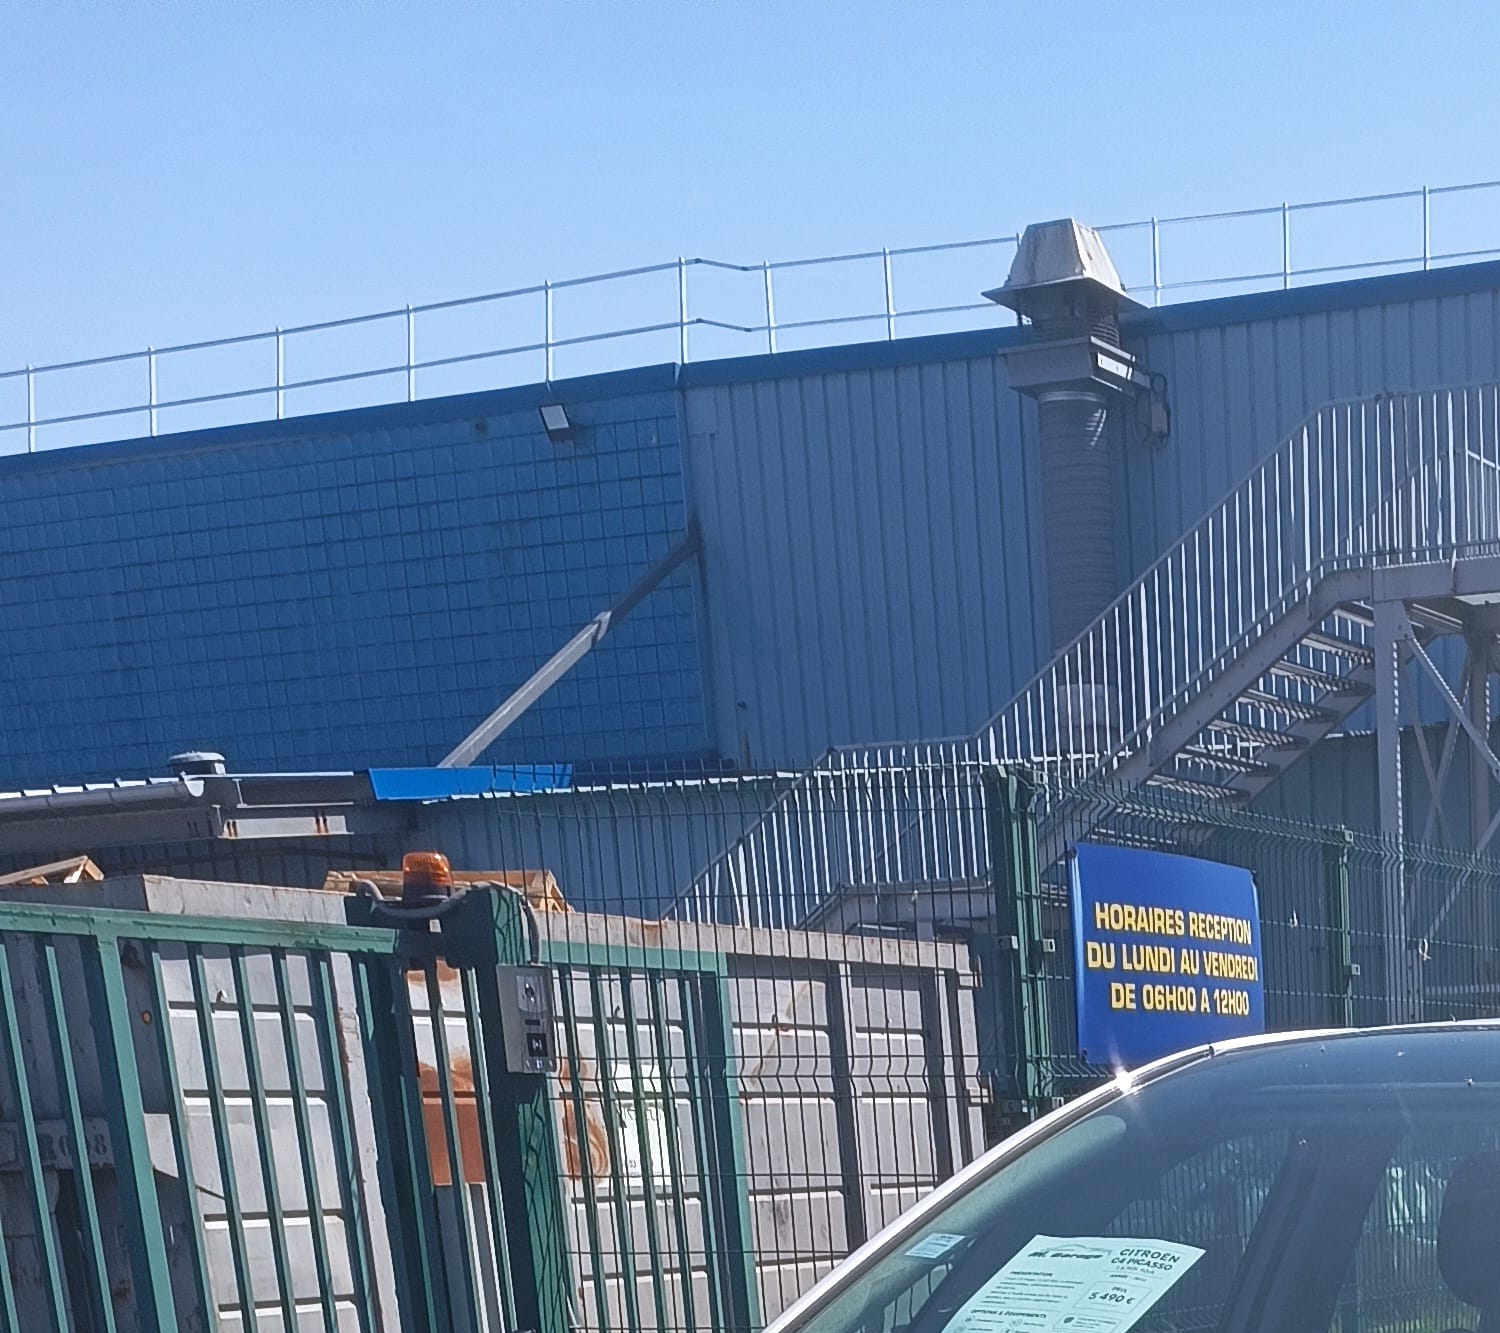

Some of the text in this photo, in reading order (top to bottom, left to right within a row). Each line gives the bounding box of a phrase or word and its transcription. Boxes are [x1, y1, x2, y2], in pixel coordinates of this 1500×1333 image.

[1095, 902, 1252, 944] HORAIRES RECEPTION
[1087, 941, 1258, 981] DU LUNDI AU VENDREDI
[1110, 983, 1250, 1015] DE 06H00 A 12H00
[1119, 1248, 1180, 1264] CITROËN
[1126, 1258, 1173, 1271] PICASSO
